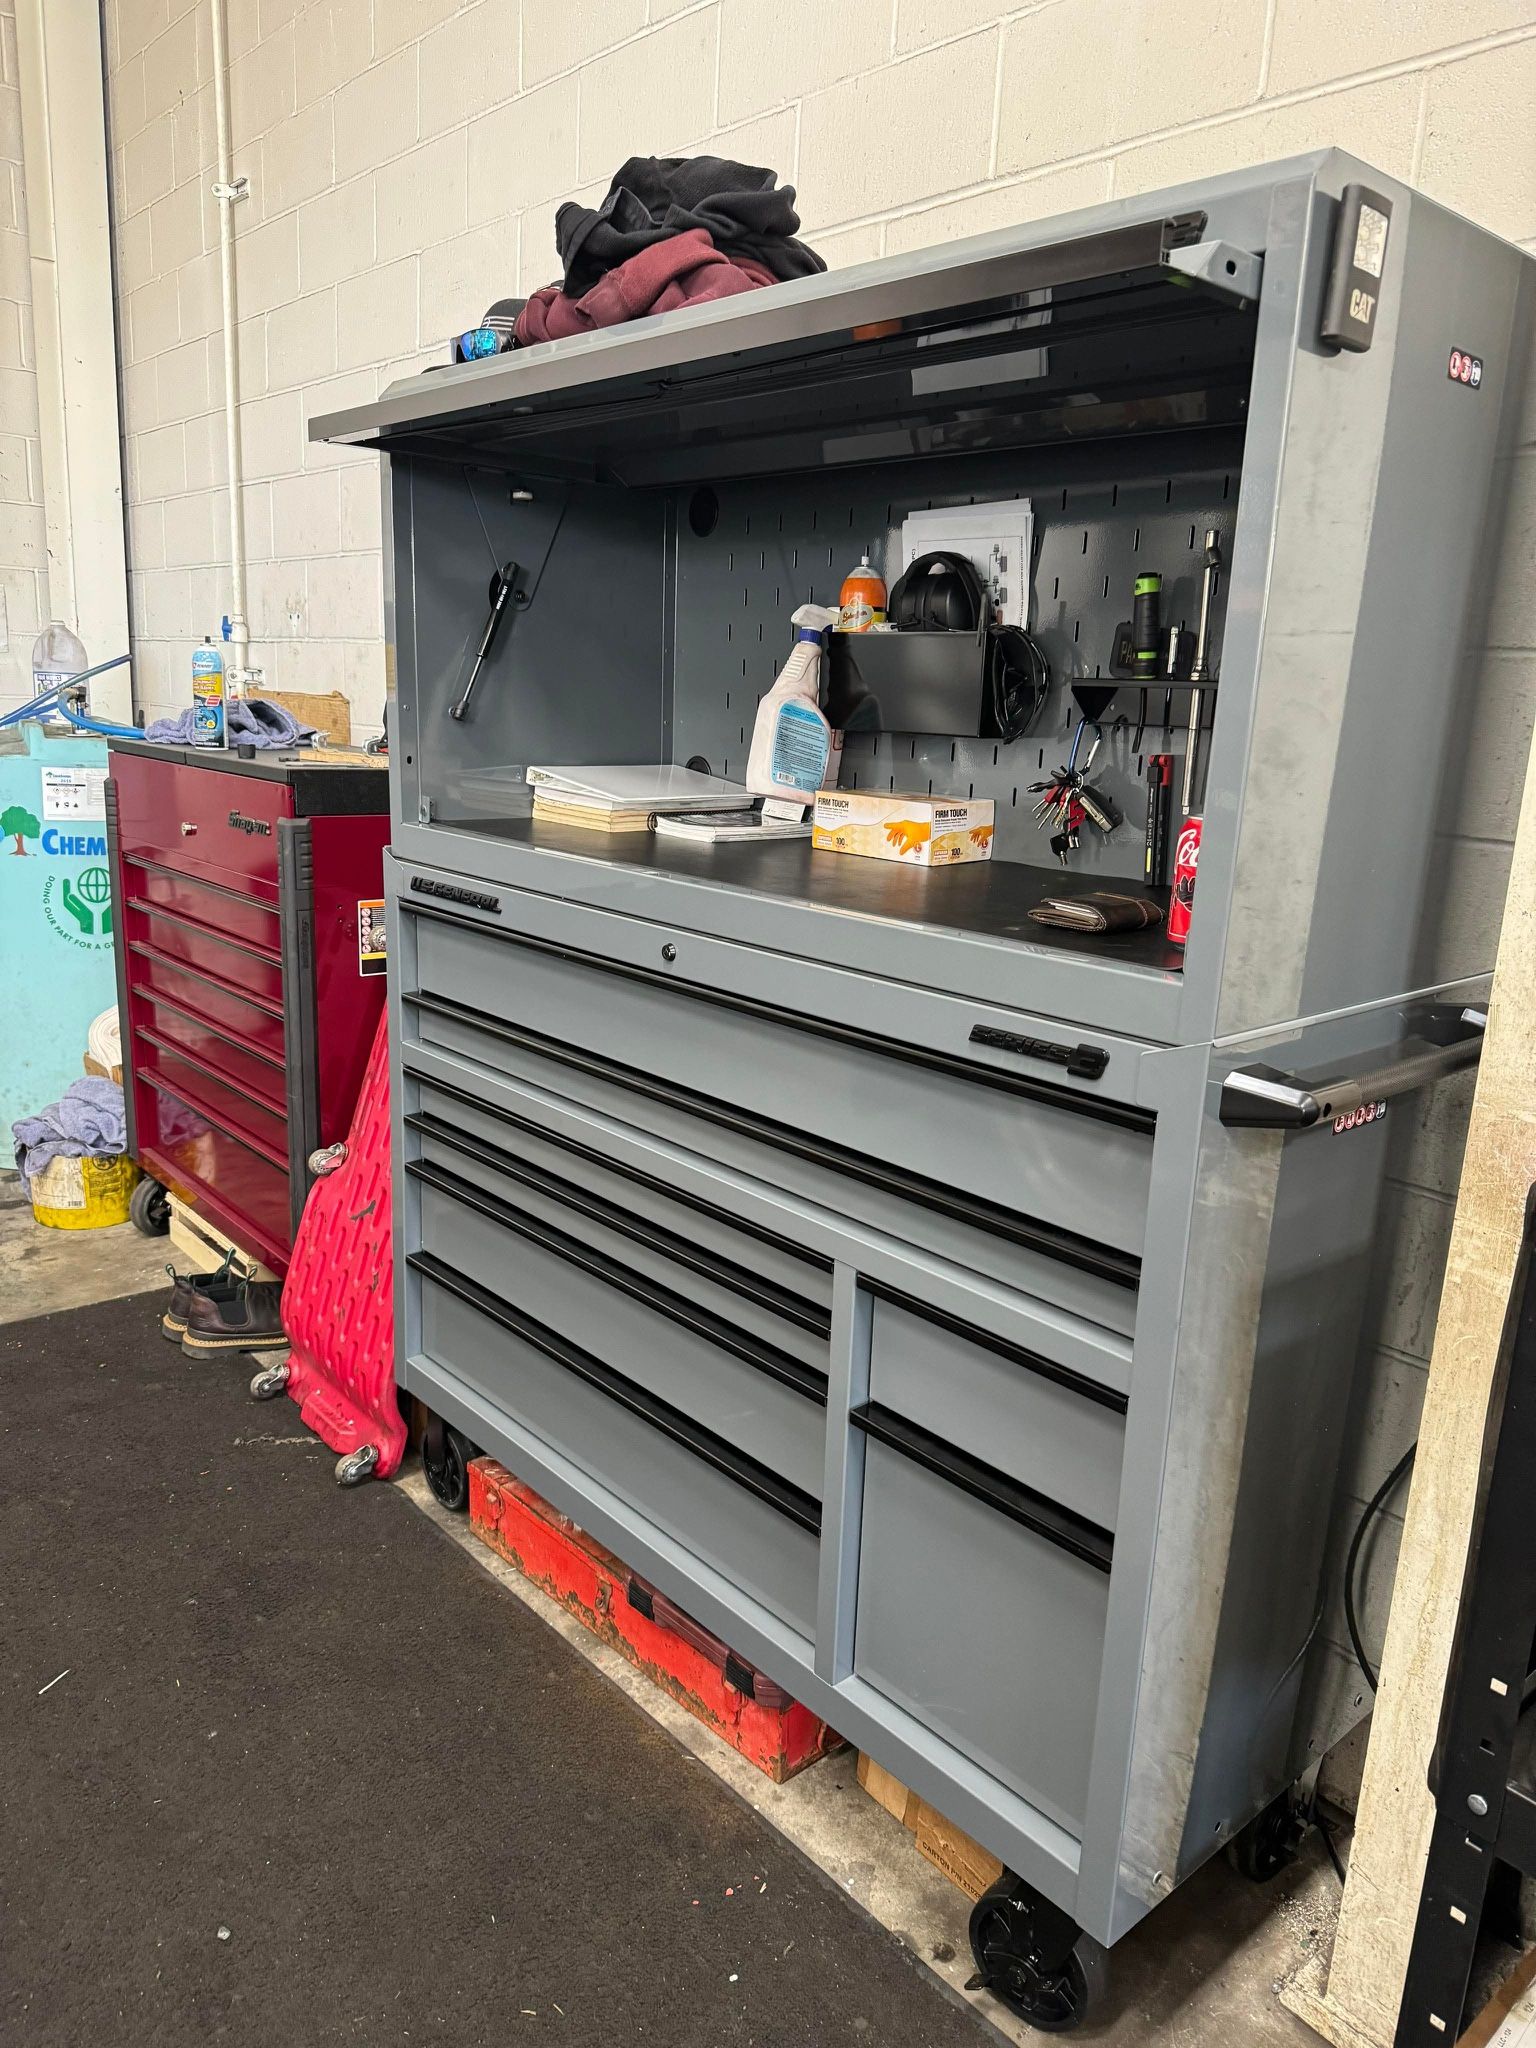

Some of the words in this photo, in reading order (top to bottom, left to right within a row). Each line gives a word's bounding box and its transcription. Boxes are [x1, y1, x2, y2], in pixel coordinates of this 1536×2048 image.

[1350, 289, 1376, 324] CAT
[818, 797, 831, 806] FIRM
[832, 799, 849, 809] TOUCH
[935, 810, 949, 818] FIRM
[950, 808, 968, 818] TOUCH
[43, 875, 56, 904] DOING
[44, 906, 57, 925] OUR
[54, 925, 74, 942] PART
[74, 938, 92, 950] FOR
[922, 1841, 950, 1871] CARTON
